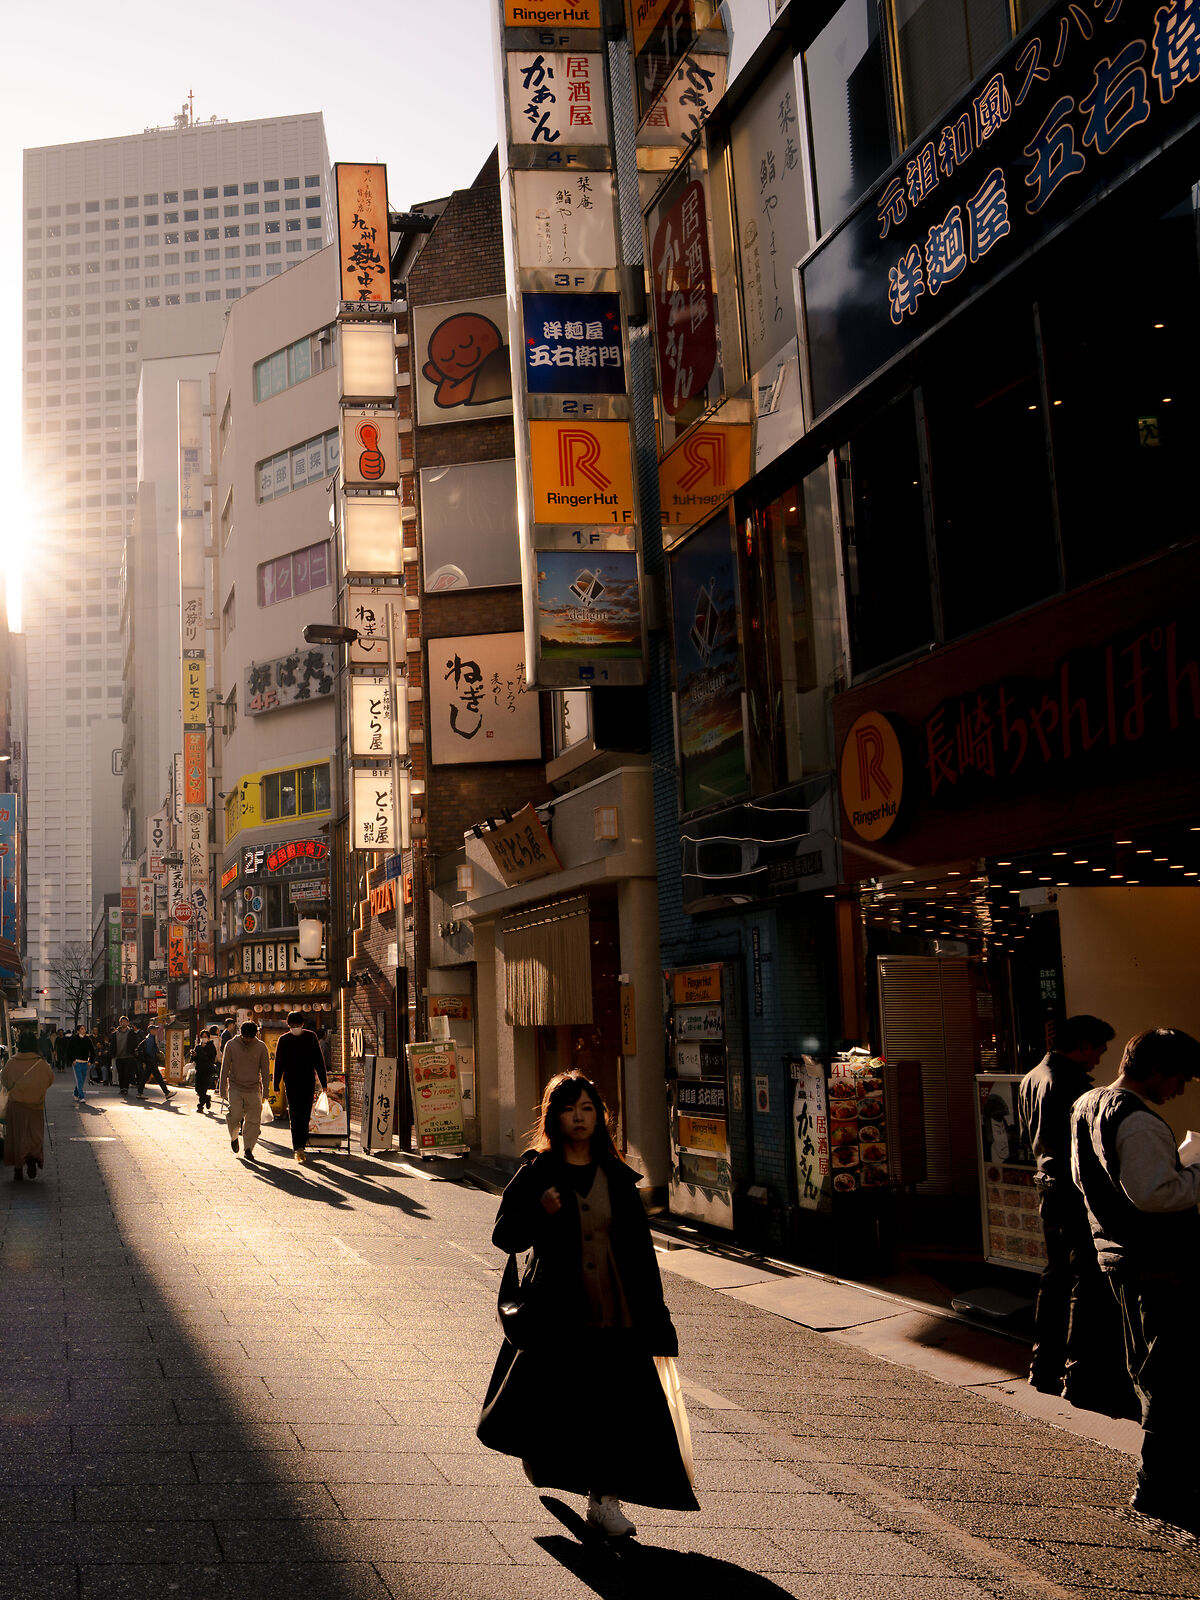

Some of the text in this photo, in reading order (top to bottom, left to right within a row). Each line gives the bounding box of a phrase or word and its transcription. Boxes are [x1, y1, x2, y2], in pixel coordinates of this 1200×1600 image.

[512, 8, 590, 23] Ringer Hut
[538, 33, 570, 46] 5F
[520, 55, 560, 142] かあさん
[566, 57, 593, 126] 居酒屋
[546, 151, 577, 164] 4F
[554, 274, 585, 287] 3F
[529, 345, 622, 368] 五右衛門
[562, 400, 594, 413] 2F
[547, 493, 618, 507] Ringer Hut
[611, 511, 632, 523] 1F
[572, 531, 600, 545] 1F
[355, 605, 377, 652] ねぎし
[490, 672, 503, 706] 麦めし
[514, 662, 528, 695] 牛たん
[444, 653, 486, 740] ねぎし
[506, 680, 516, 713] とろろ
[369, 699, 384, 751] とら屋
[374, 790, 390, 844] とら屋
[852, 801, 897, 827] Ringer Hut
[152, 818, 163, 848] TOY
[244, 850, 265, 874] 2F
[370, 882, 393, 917] PIZZA
[377, 1094, 391, 1136] ねぎし
[796, 1102, 818, 1199] かあさん
[816, 1115, 829, 1176] 居酒屋
